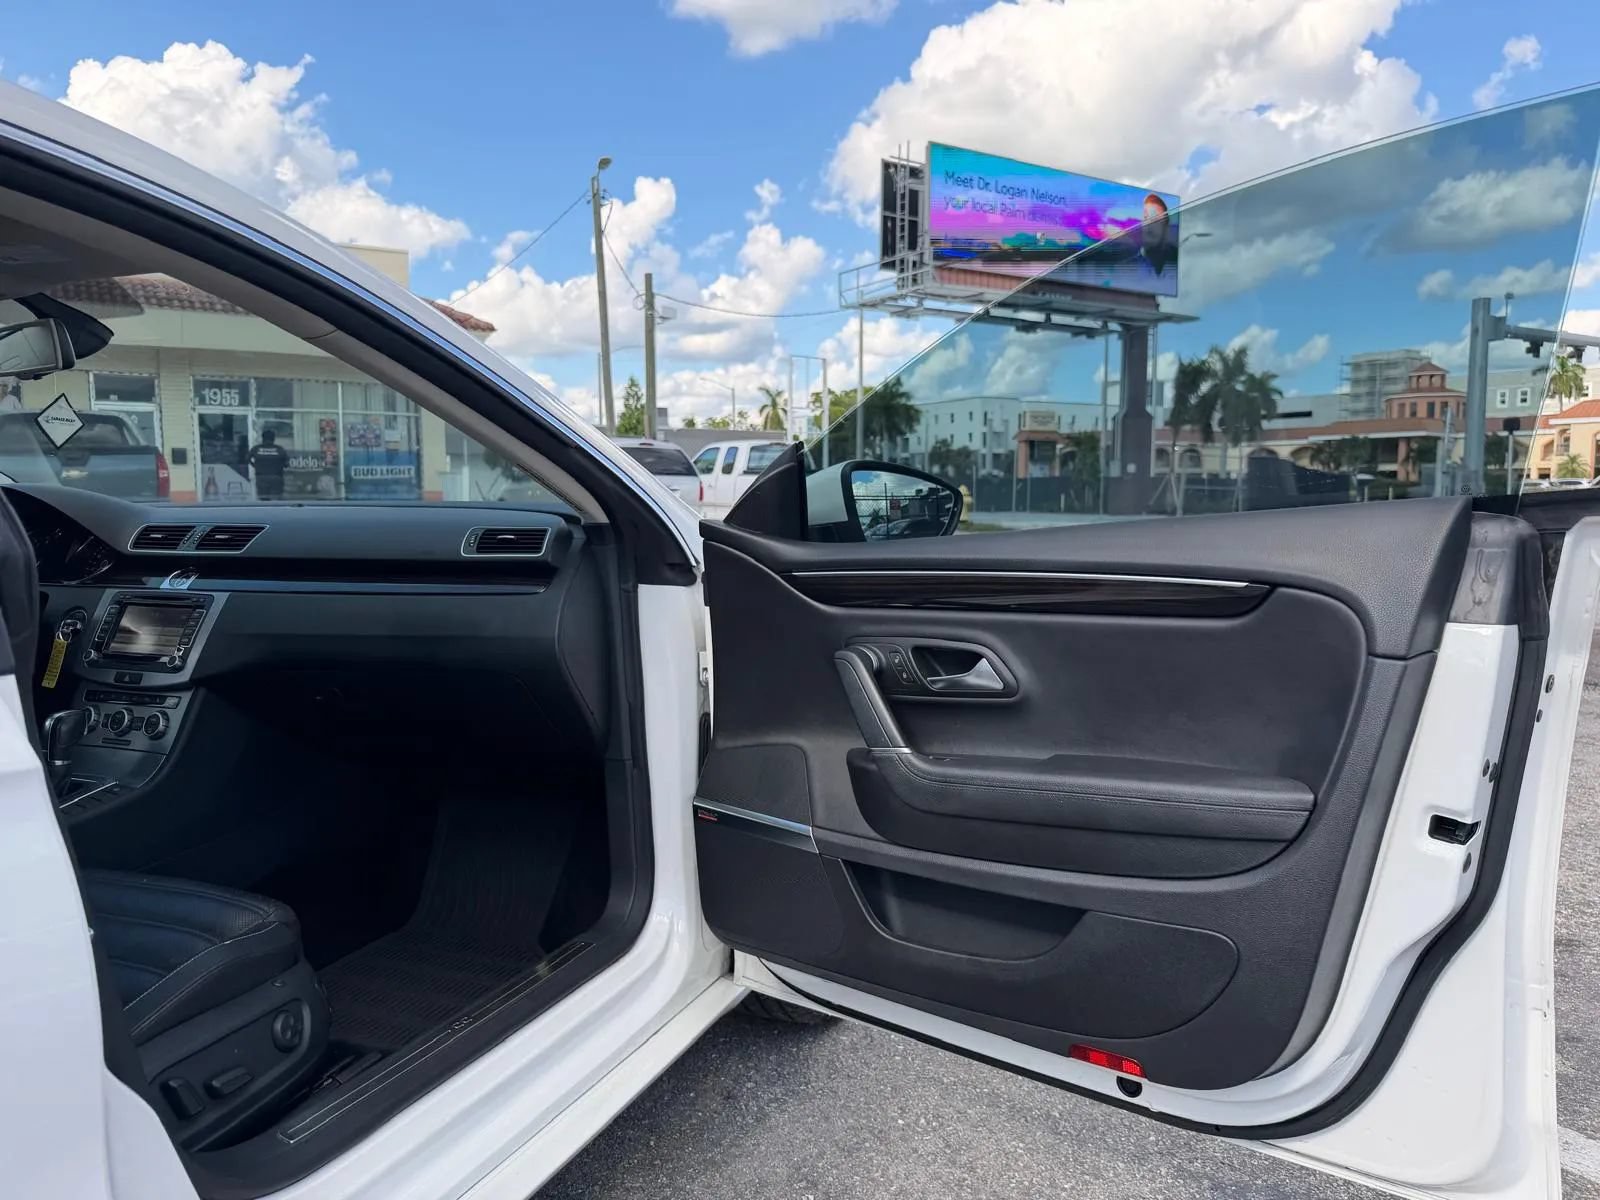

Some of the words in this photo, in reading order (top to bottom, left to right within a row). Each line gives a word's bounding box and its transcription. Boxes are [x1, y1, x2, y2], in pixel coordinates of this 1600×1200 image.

[944, 170, 974, 189] Meet
[995, 180, 1028, 200] Logan
[944, 196, 969, 211] your
[201, 388, 240, 406] 1955
[289, 456, 318, 468] odelo
[353, 467, 378, 477] BUD
[380, 467, 413, 477] LIGHT
